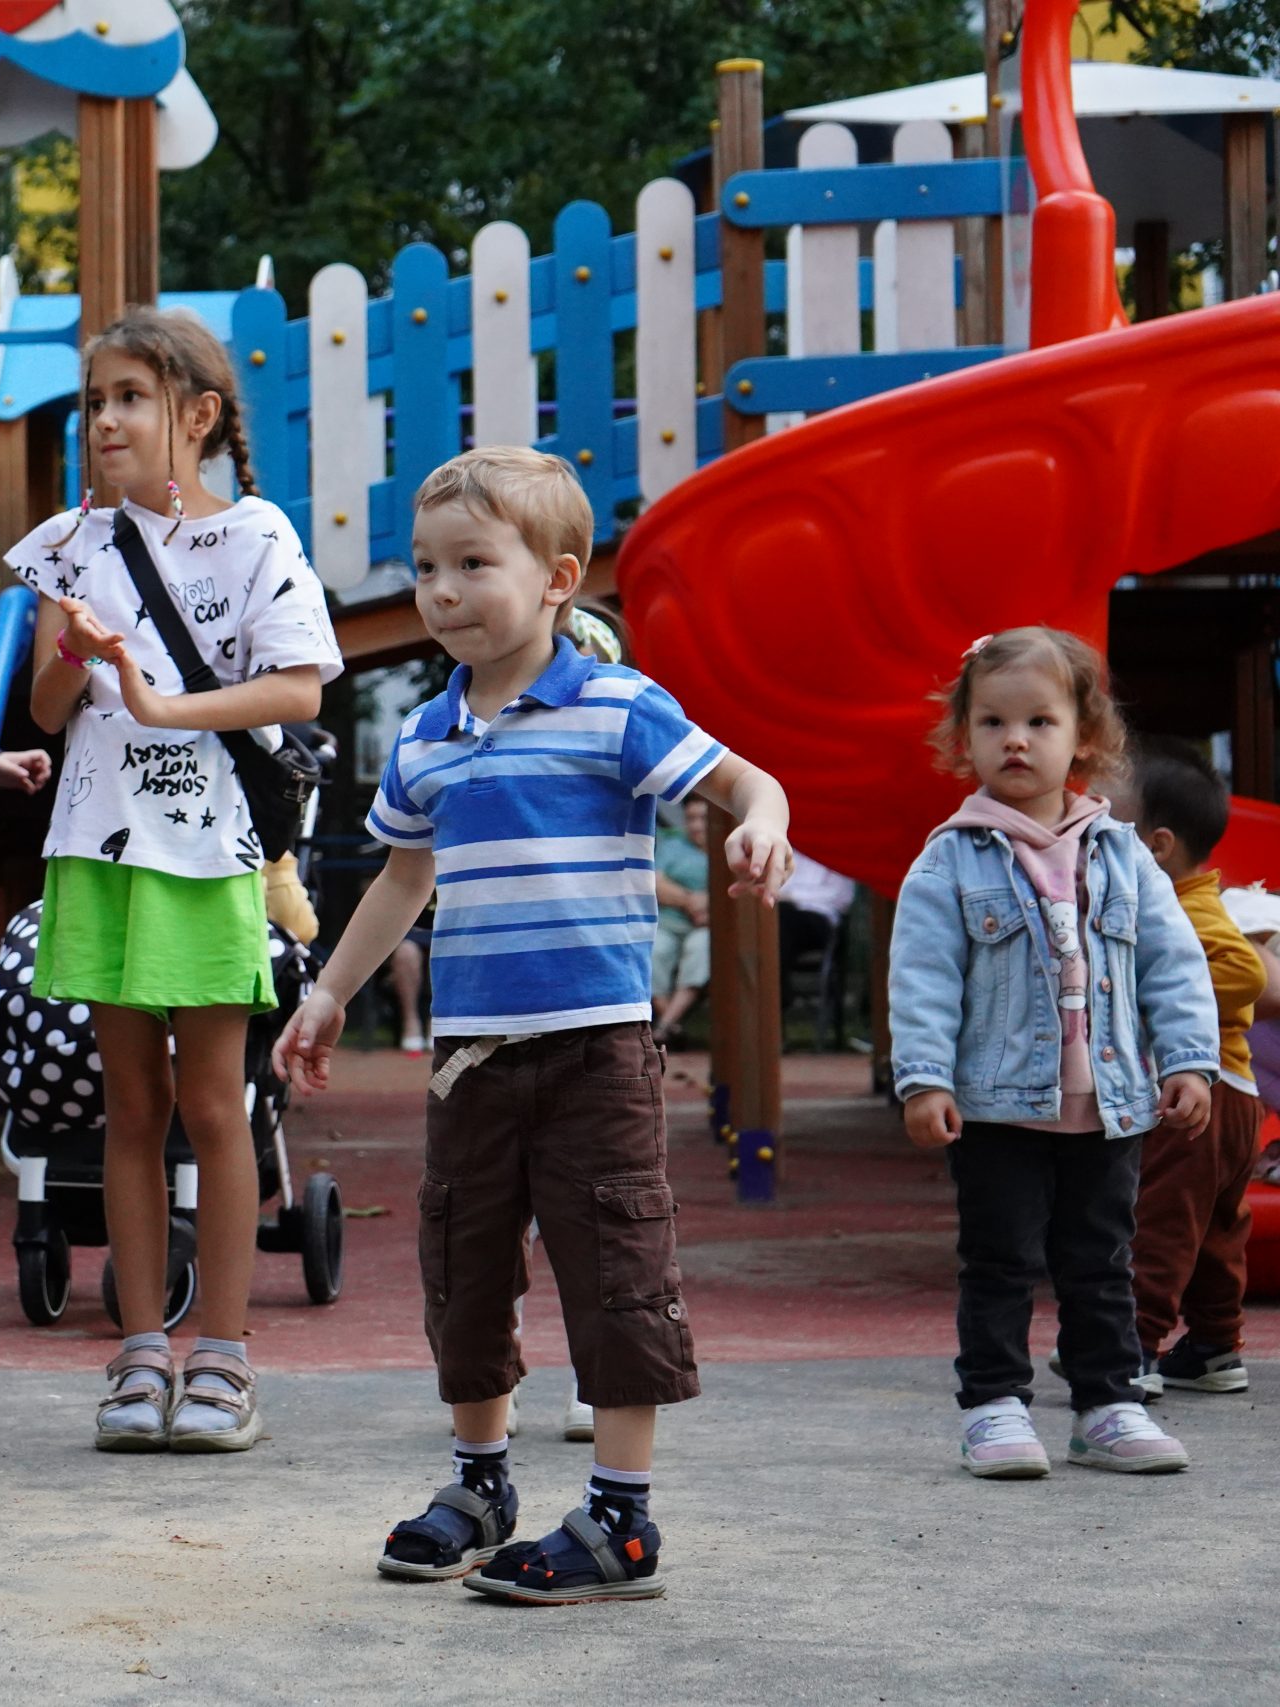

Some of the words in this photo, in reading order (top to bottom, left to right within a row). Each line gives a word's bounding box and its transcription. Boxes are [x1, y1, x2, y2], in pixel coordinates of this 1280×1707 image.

[194, 597, 230, 624] can
[120, 741, 196, 771] SORRY
[155, 760, 198, 777] NOT
[133, 769, 209, 797] SORRY
